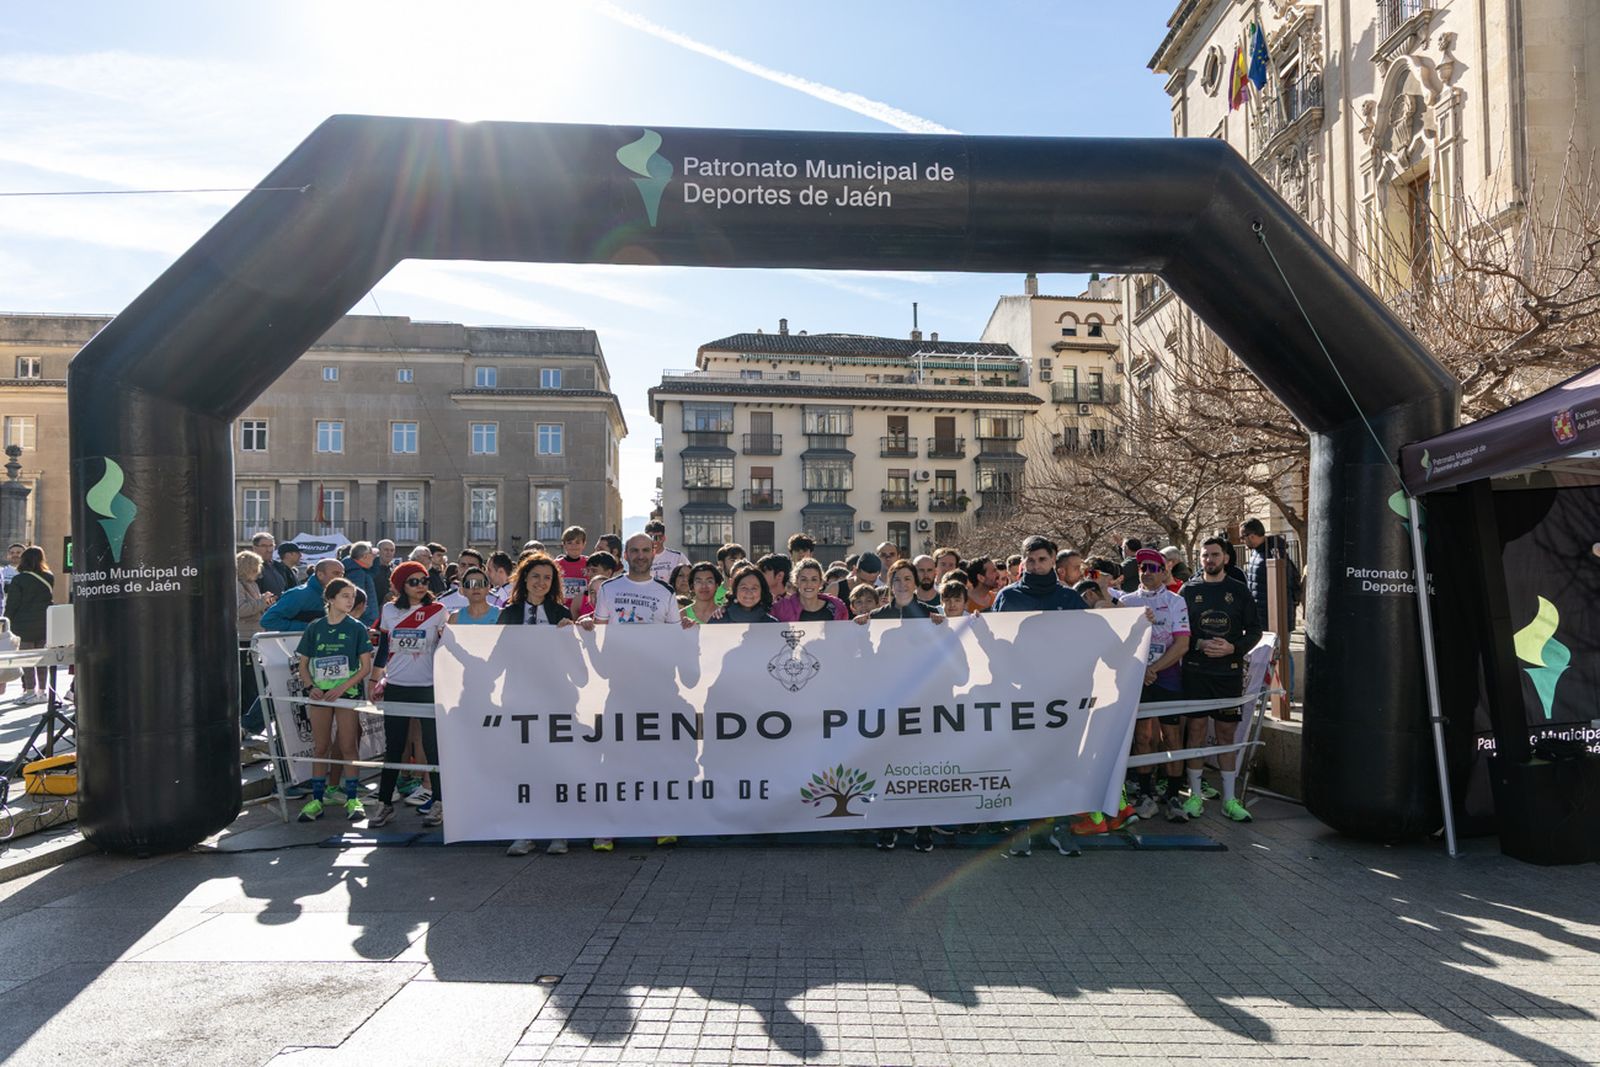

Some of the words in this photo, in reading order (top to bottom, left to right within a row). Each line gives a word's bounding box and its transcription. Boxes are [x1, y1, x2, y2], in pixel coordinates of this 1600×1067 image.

[683, 157, 798, 178] Patronato
[805, 159, 918, 184] Municipal
[925, 163, 955, 181] de
[683, 183, 791, 208] Deportes
[799, 185, 828, 206] de
[835, 185, 892, 208] Jaén
[110, 566, 177, 580] Municipal
[181, 566, 198, 576] de
[1346, 567, 1408, 579] Patronato
[76, 584, 120, 598] Deportes
[124, 581, 142, 593] de
[146, 580, 180, 592] Jaén
[565, 585, 580, 594] 264
[398, 638, 418, 647] 697
[323, 664, 341, 676] 758
[884, 761, 961, 777] Asociación
[518, 783, 531, 804] A
[556, 779, 714, 803] BENEFICIO
[739, 779, 769, 800] DE
[885, 775, 1012, 795] ASPERGER-TEA
[976, 793, 1012, 810] Jaén
